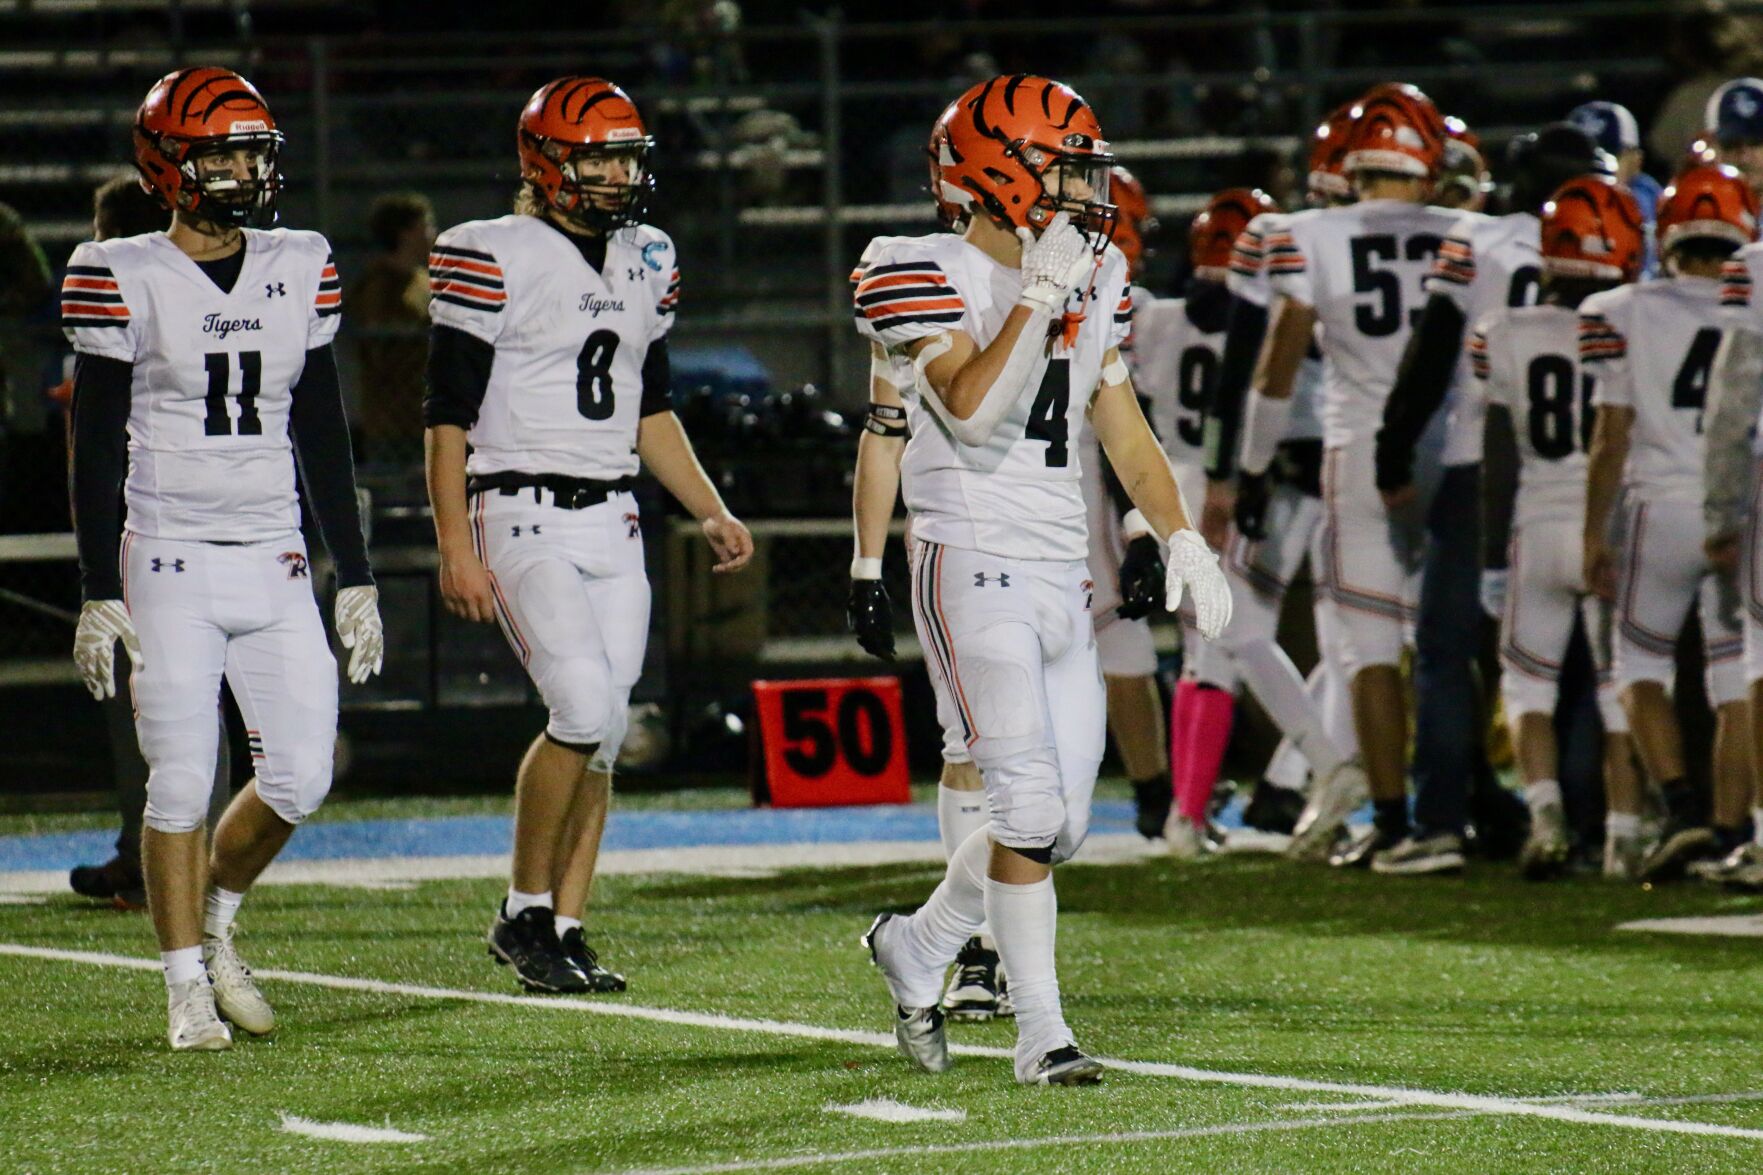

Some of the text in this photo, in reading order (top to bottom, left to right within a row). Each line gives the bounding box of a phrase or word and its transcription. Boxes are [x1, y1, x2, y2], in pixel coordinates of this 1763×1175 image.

[202, 312, 263, 340] Tigers
[578, 292, 626, 318] Tigers
[204, 350, 263, 436] 11
[576, 328, 621, 421] 8
[1024, 358, 1070, 468] 4
[780, 688, 893, 780] 50
